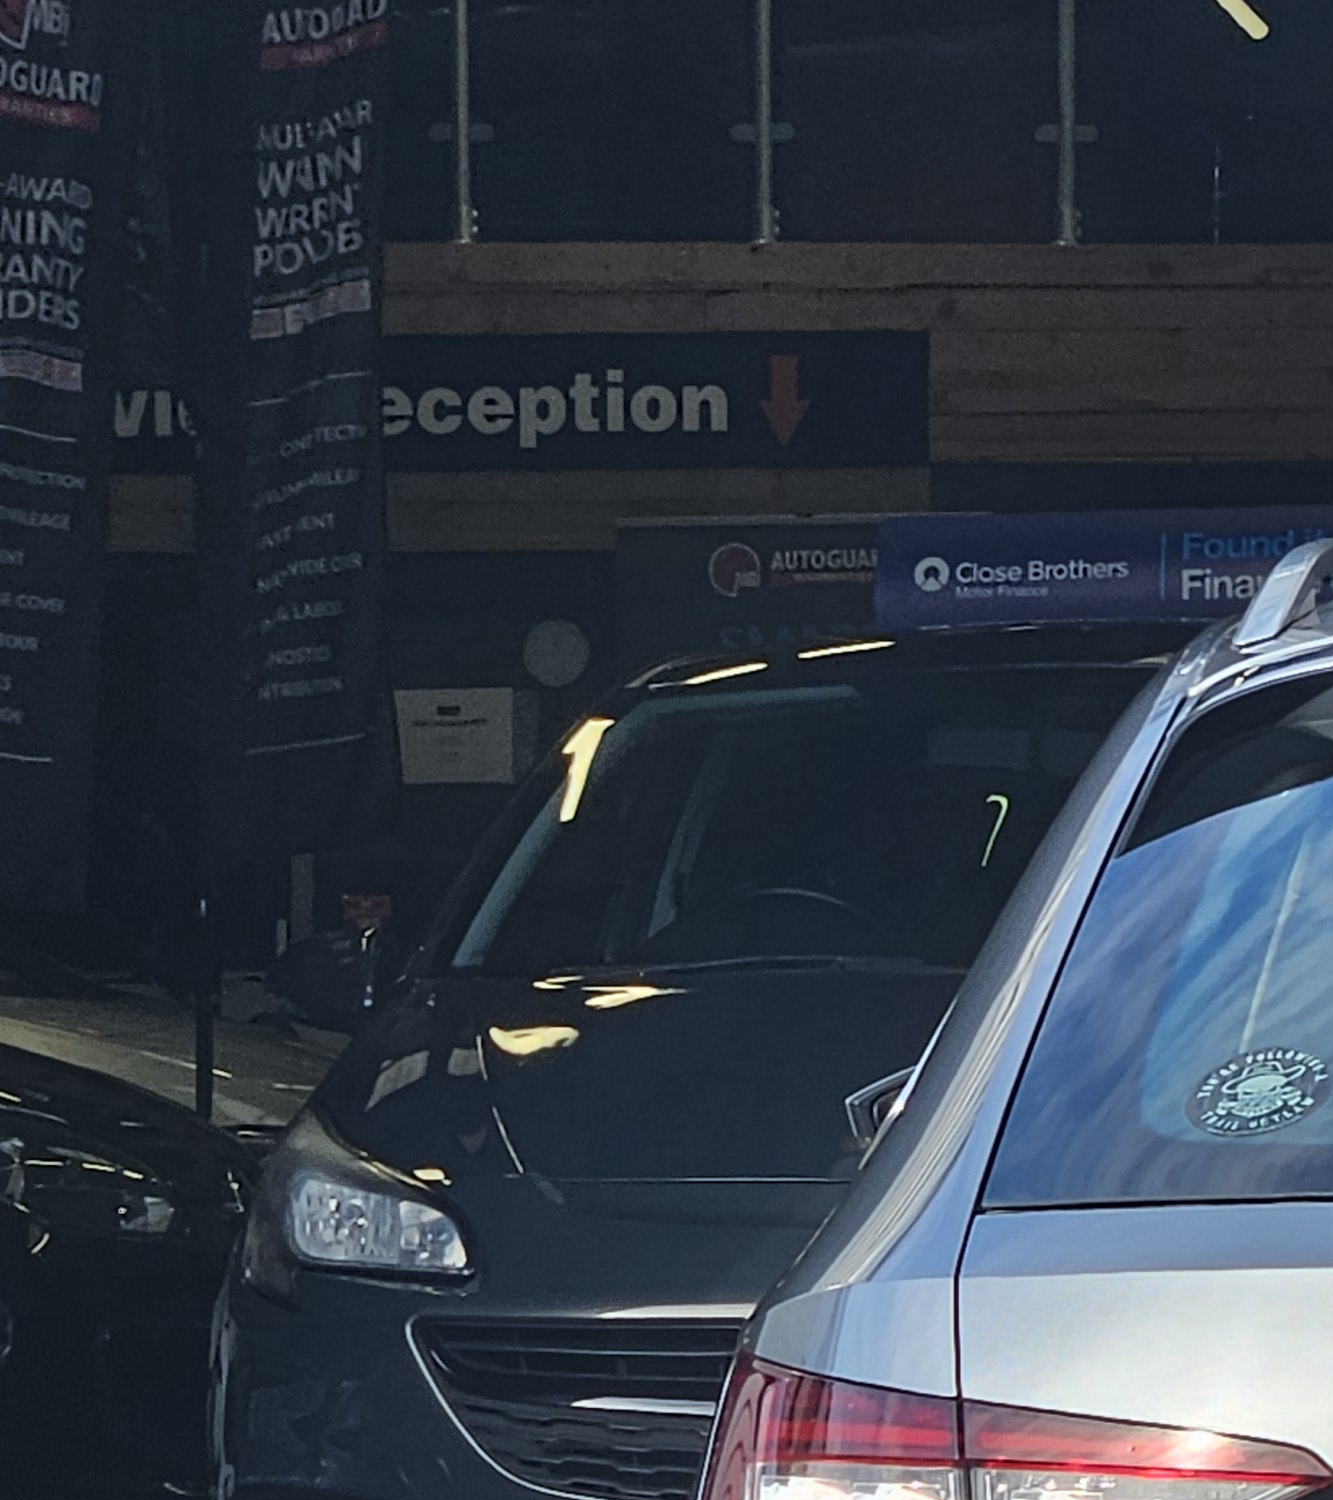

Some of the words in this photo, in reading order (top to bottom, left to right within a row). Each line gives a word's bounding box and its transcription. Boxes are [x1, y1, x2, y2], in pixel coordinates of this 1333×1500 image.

[383, 369, 728, 448] eception
[1183, 529, 1295, 560] Found
[955, 562, 1023, 584] Close
[1028, 559, 1129, 581] Brothers
[1181, 568, 1262, 600] Fina
